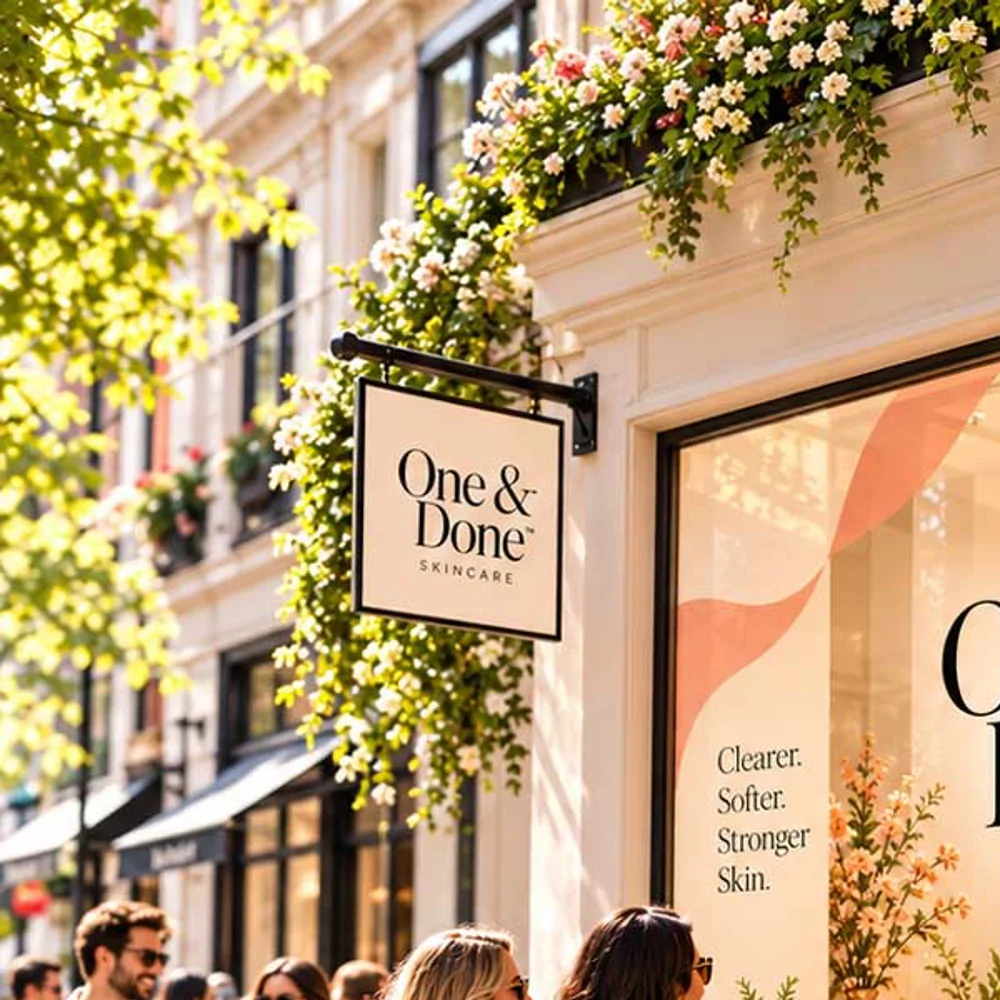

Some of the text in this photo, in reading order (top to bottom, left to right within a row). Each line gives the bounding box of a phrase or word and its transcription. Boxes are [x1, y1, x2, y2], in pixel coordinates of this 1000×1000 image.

[398, 448, 537, 517] One &
[420, 560, 514, 584] SKINCARE
[717, 745, 802, 774] Clearer.
[717, 784, 786, 815] Softer.
[717, 827, 811, 857] Stronger
[717, 866, 771, 894] Skin.
